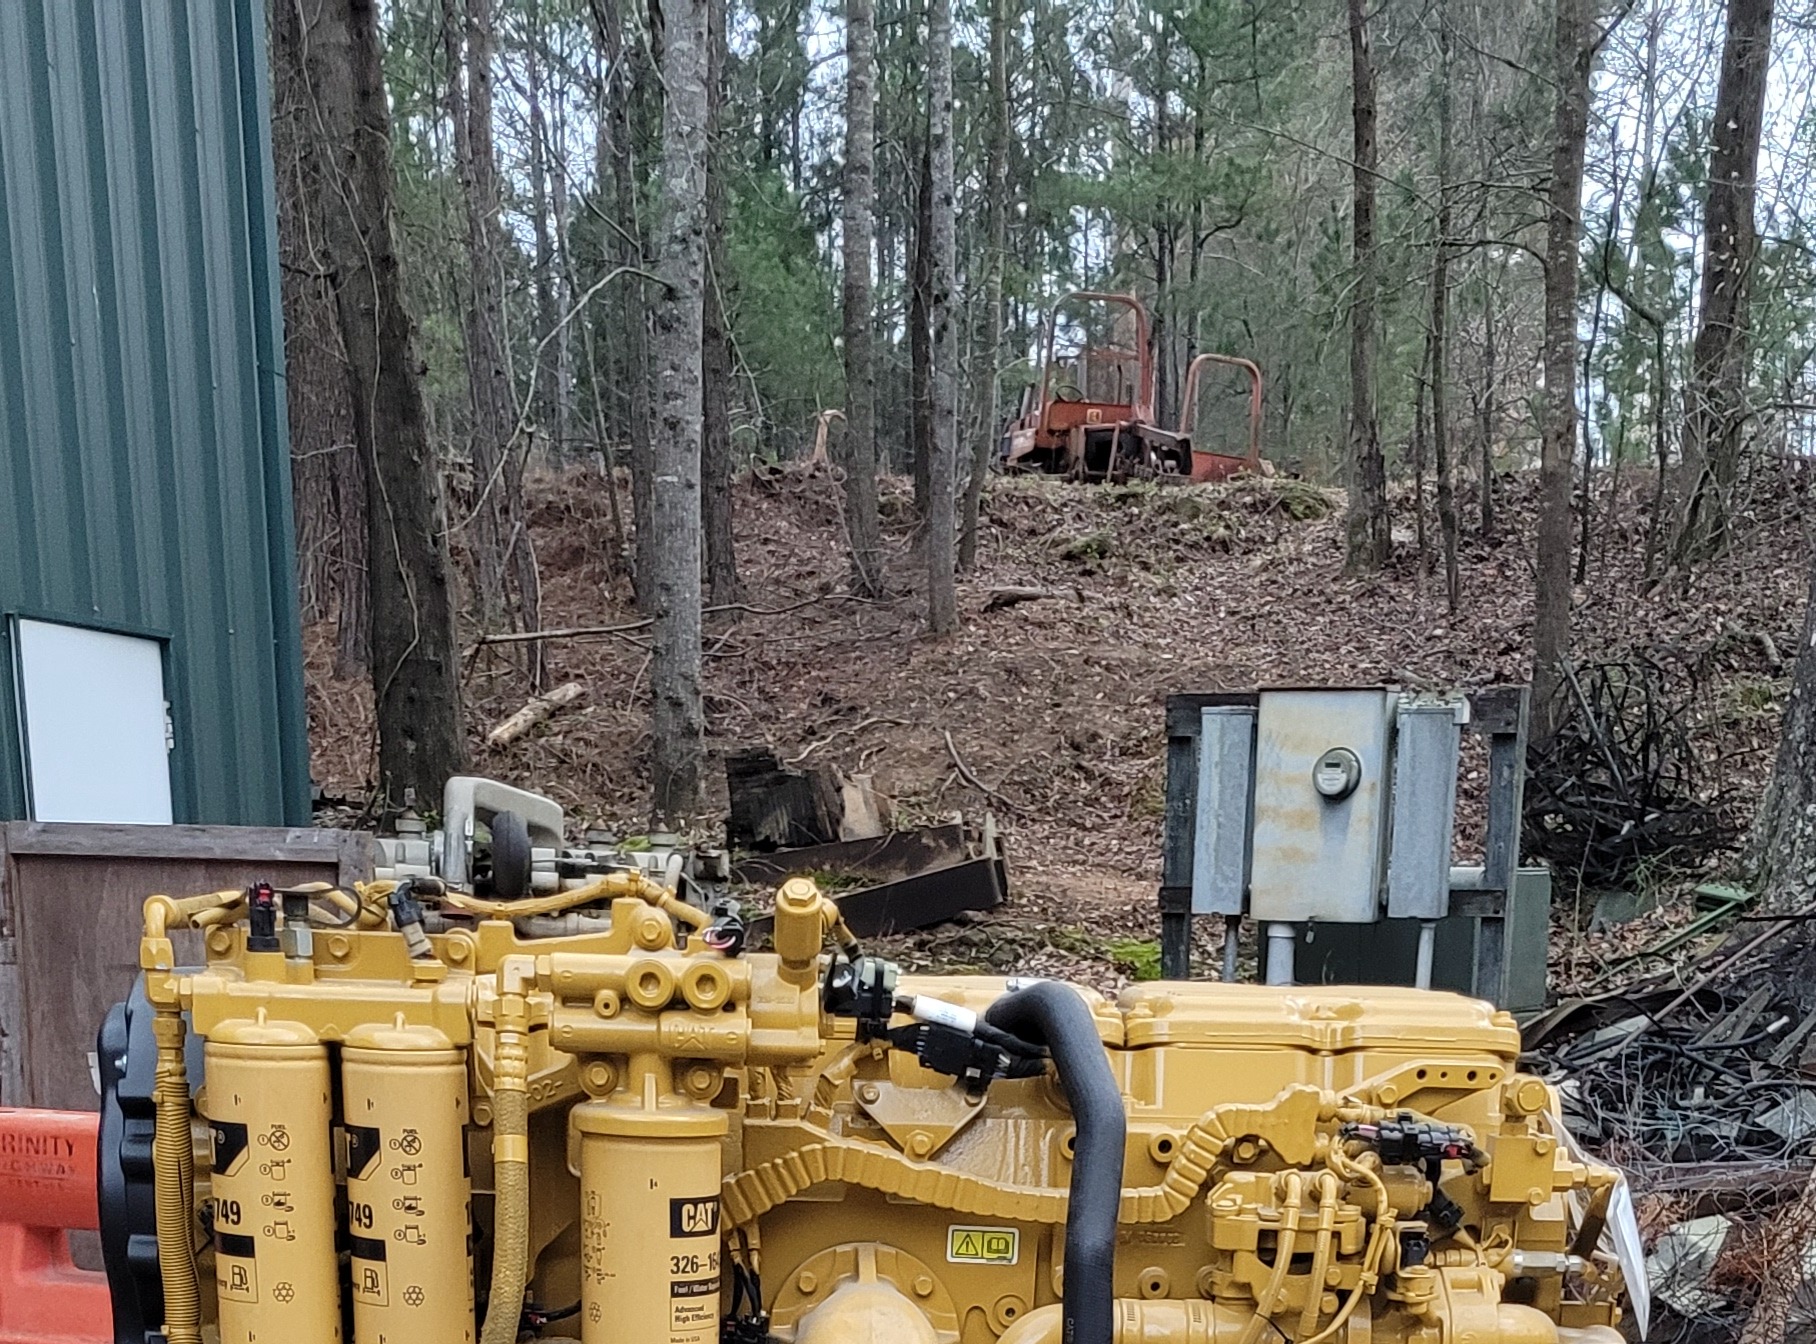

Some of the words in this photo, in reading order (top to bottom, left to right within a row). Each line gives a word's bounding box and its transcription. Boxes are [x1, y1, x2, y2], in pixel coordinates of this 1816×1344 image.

[2, 1132, 75, 1158] RINITY
[681, 1201, 714, 1233] CAT
[670, 1251, 719, 1275] 326-16
